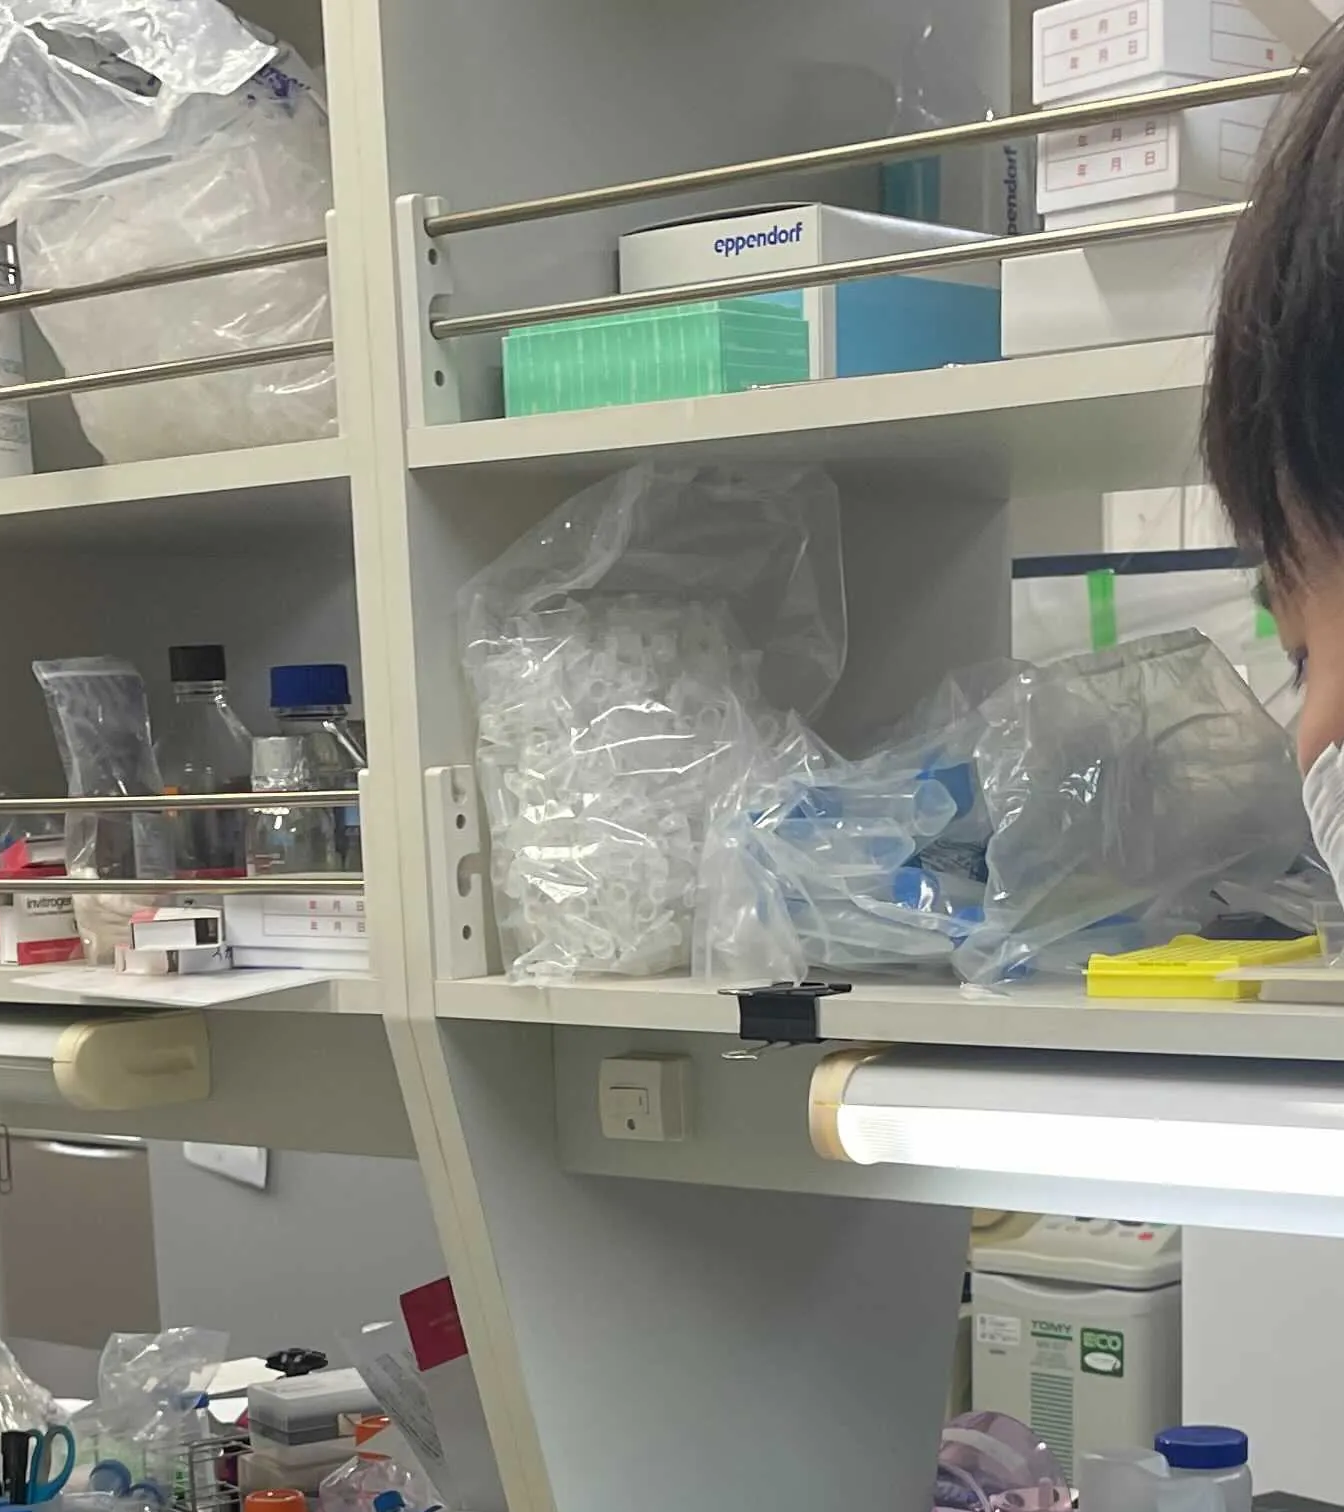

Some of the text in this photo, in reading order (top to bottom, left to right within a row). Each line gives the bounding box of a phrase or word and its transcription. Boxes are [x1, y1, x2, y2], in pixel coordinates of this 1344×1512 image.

[1003, 145, 1018, 236] pendorf
[714, 221, 803, 257] eppendorf
[1031, 1319, 1072, 1334] TOMY
[1082, 1332, 1122, 1351] ECO
